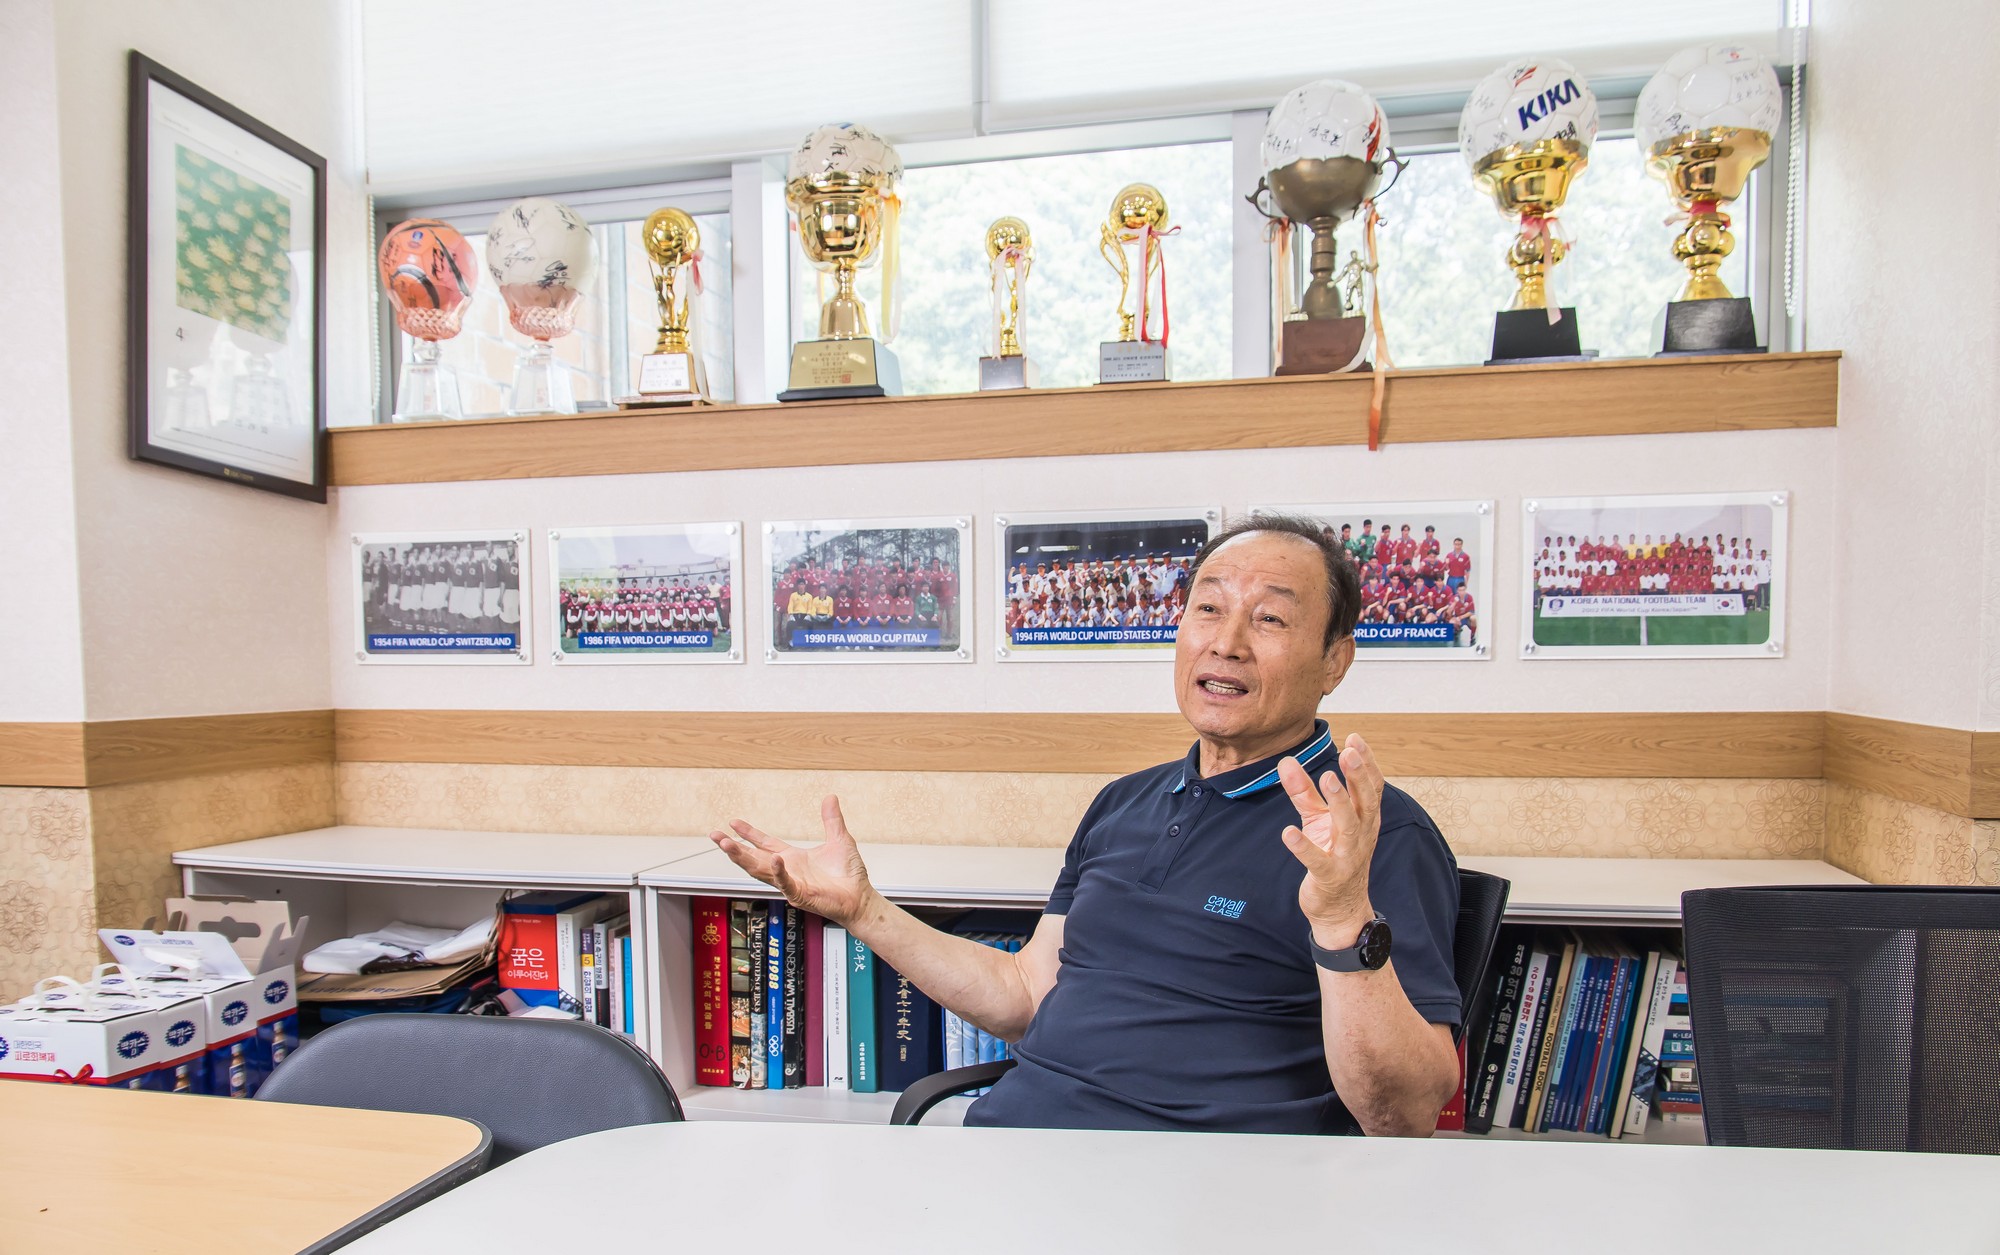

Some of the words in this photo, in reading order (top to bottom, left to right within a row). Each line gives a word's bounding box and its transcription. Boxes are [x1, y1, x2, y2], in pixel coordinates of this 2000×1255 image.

[583, 636, 603, 645] 1986
[605, 636, 621, 644] FIFA
[623, 636, 652, 644] WORLD
[655, 636, 672, 644] CUP
[674, 635, 708, 644] MEXICO
[804, 634, 825, 643] 1990
[827, 634, 845, 643] FIFA
[847, 634, 877, 642] WORLD
[880, 634, 900, 642] CUP
[903, 633, 928, 642] ITALY
[1015, 633, 1033, 642] 1994
[1034, 632, 1049, 641] FIFA
[1050, 631, 1077, 641] WORLD
[1079, 631, 1095, 641] CUP
[1096, 631, 1123, 640] UNITED
[1124, 630, 1151, 640] STATES
[1153, 630, 1164, 639] OF
[1352, 628, 1379, 638] ORLD
[1382, 628, 1401, 637] CUP
[1404, 628, 1447, 637] FRANCE
[373, 638, 390, 647] 1954
[392, 638, 408, 646] FIFA
[409, 638, 436, 646] WORLD
[438, 638, 454, 646] CUP
[455, 637, 511, 646] SWITZERLAND
[1203, 903, 1241, 919] CLASS
[1208, 895, 1247, 912] cavalli
[511, 948, 545, 968] 꿈은
[583, 957, 590, 965] 5
[507, 969, 548, 981] 이루어진다
[769, 960, 780, 989] 1988
[1527, 966, 1539, 994] 2019
[786, 998, 796, 1034] FUSSBALL
[1541, 1032, 1554, 1068] FOOTBALL
[1535, 1071, 1545, 1092] BOOK
